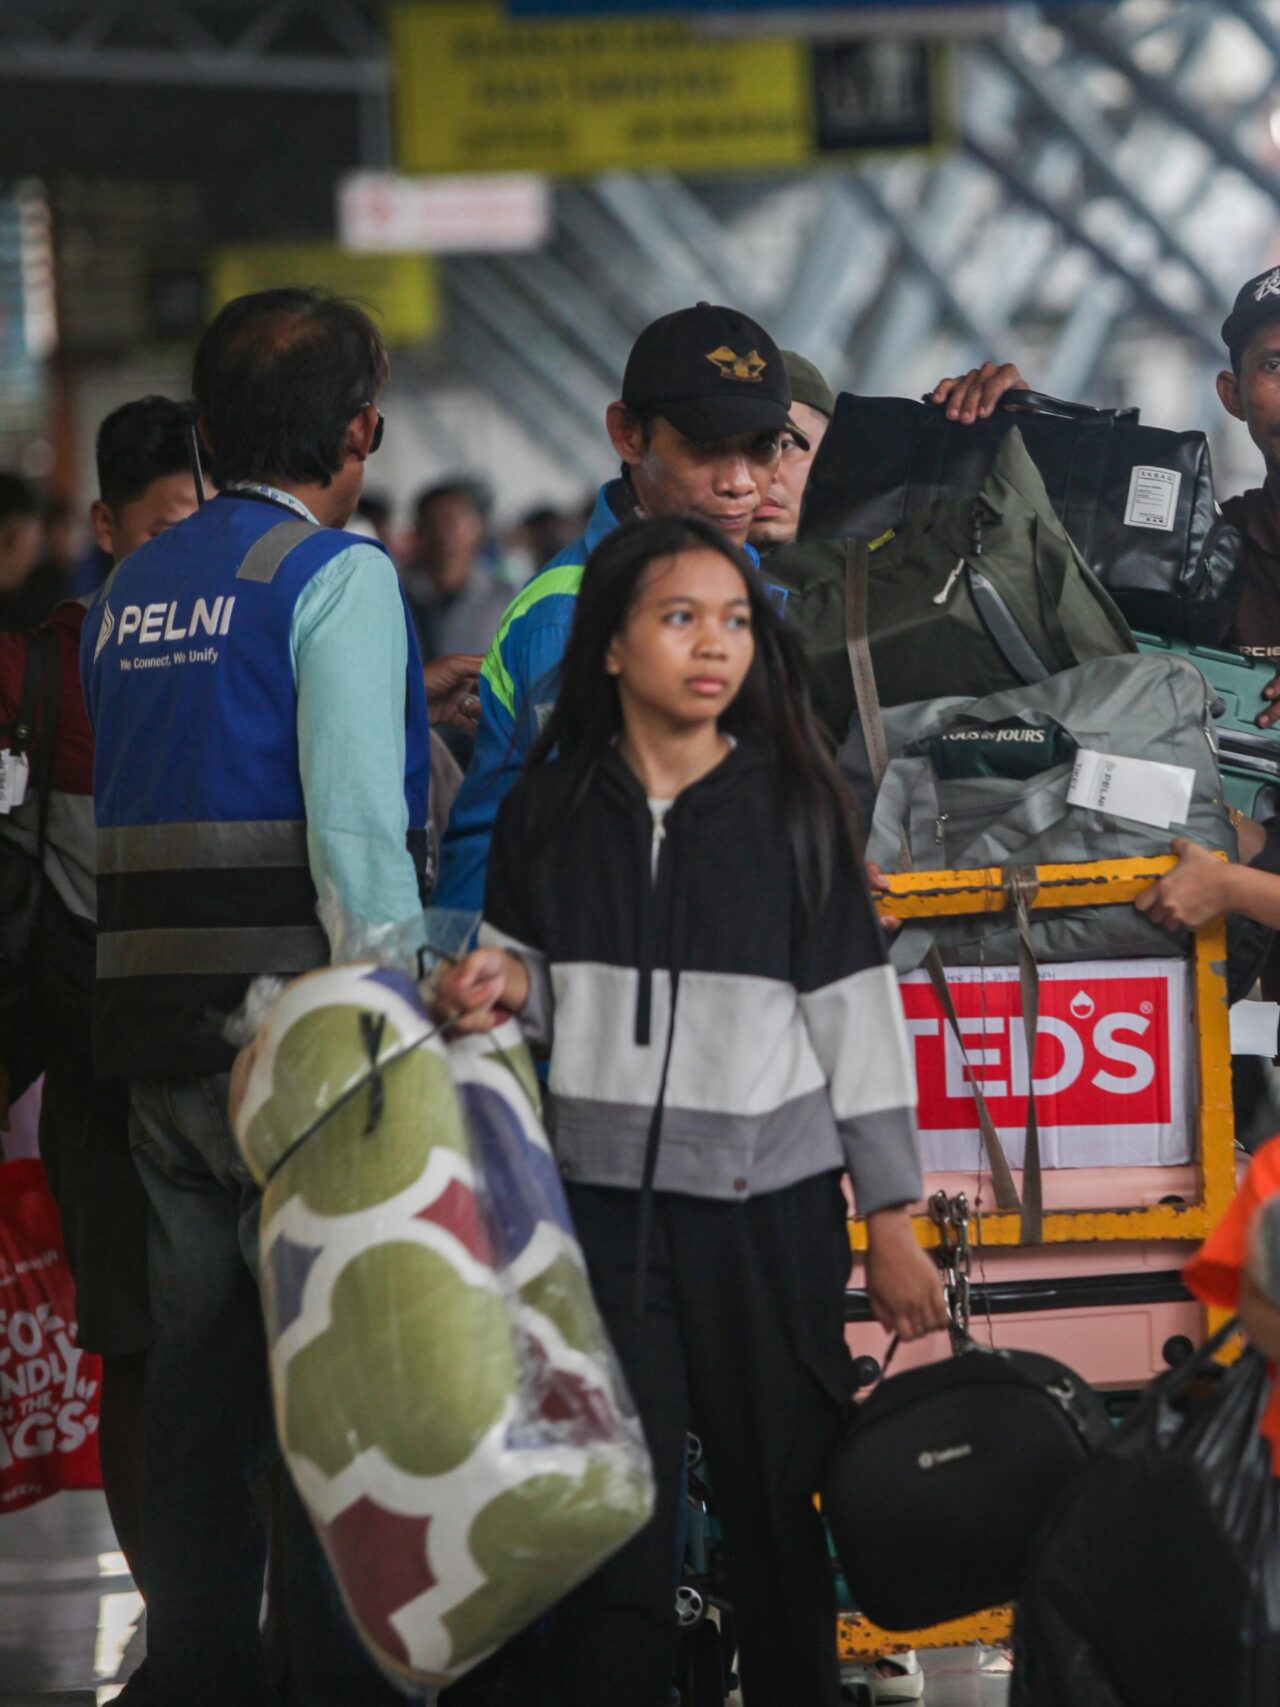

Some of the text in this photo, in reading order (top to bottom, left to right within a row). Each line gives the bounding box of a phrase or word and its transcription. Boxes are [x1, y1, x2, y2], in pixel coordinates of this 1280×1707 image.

[117, 595, 236, 646] PELNI
[120, 659, 132, 672] We
[173, 652, 186, 665] We
[189, 647, 219, 665] Unify
[996, 729, 1046, 743] JOURS
[1096, 773, 1112, 807] PELNI
